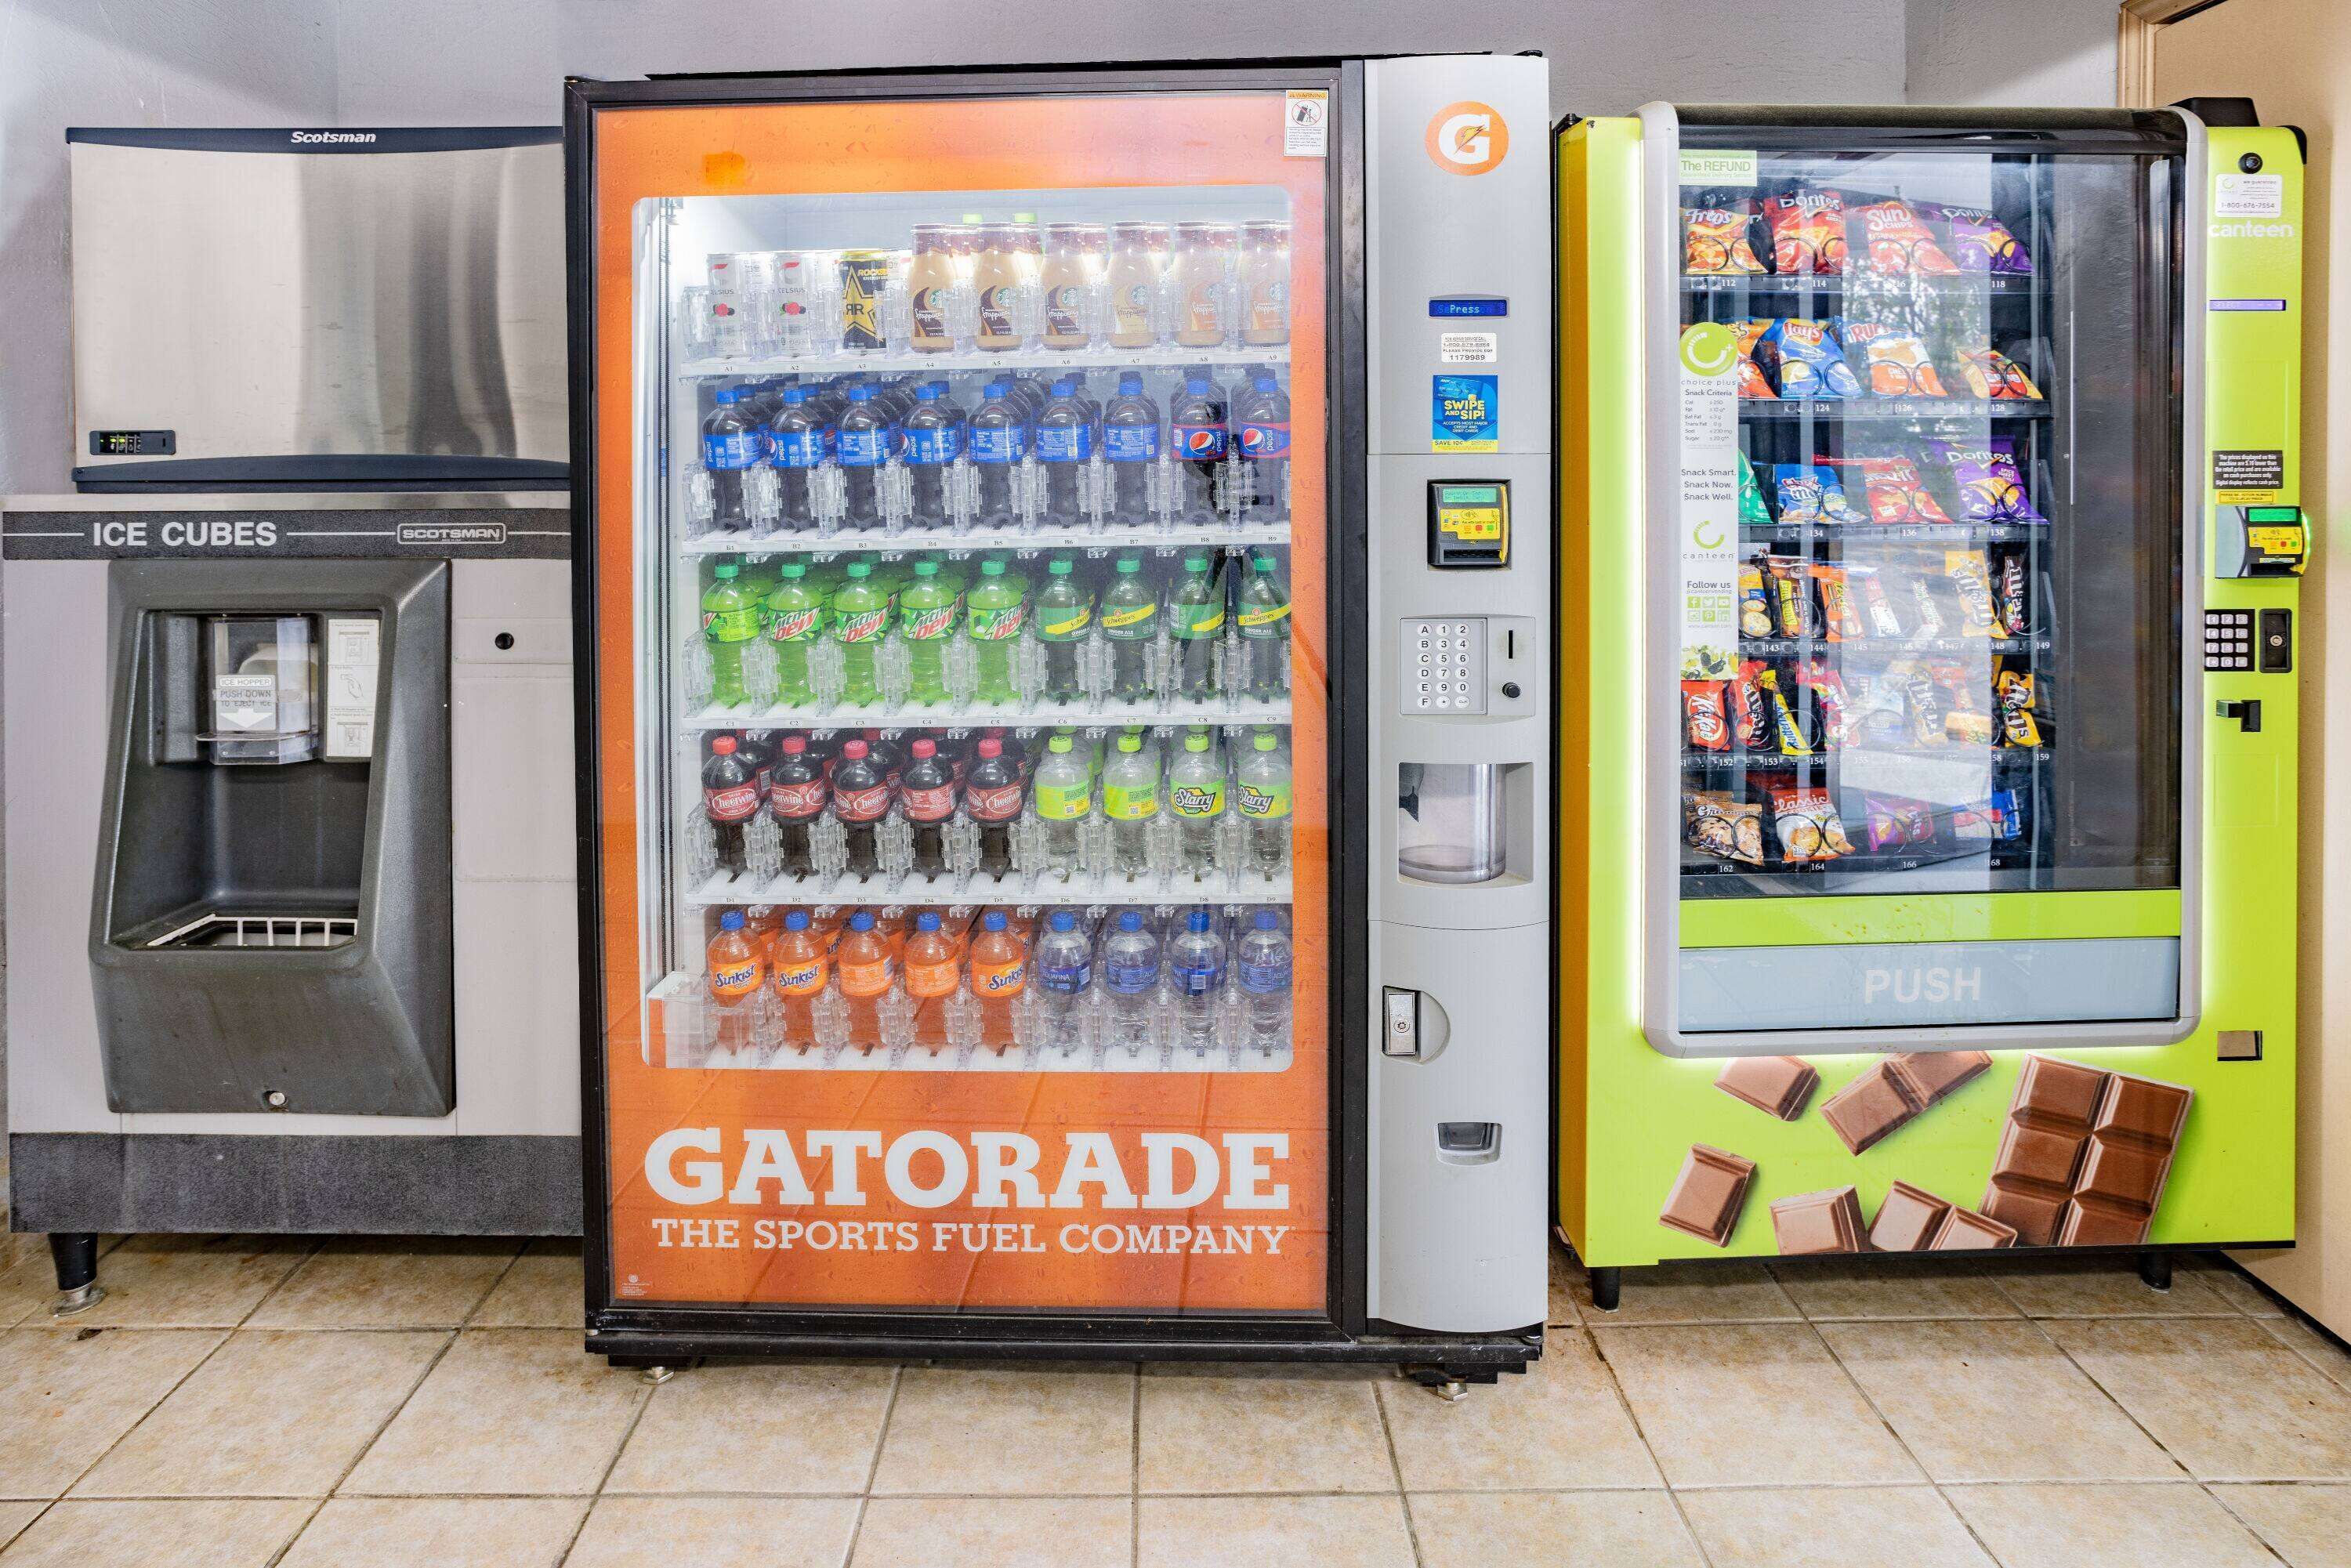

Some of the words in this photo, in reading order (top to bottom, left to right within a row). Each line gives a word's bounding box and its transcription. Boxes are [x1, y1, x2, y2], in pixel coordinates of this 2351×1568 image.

[291, 131, 376, 143] Scotsman
[1681, 160, 1701, 171] The
[1704, 160, 1751, 172] REFUND
[1780, 194, 1840, 211] Doritos
[1867, 208, 1911, 231] Sun
[2208, 221, 2294, 237] canteen
[1450, 305, 1480, 313] Press
[1785, 322, 1820, 340] Lay's
[1444, 400, 1484, 410] SWIPE
[1460, 410, 1485, 419] SIP!
[777, 440, 786, 461] pepsi
[909, 436, 918, 457] pepsi
[1946, 451, 2014, 464] Doritos
[94, 522, 147, 546] ICE
[161, 521, 277, 546] CUBES
[402, 529, 500, 539] SCOTSMAN
[774, 610, 817, 641] DEW
[845, 611, 886, 642] DEW
[915, 607, 953, 639] DEW
[1243, 614, 1274, 625] Schweppes
[712, 791, 756, 809] Cheerwine
[1174, 788, 1216, 812] Starry
[1239, 785, 1274, 813] Starry
[715, 964, 756, 987] Sunkist
[779, 964, 820, 987] Sunkist
[1865, 967, 1981, 1003] PUSH
[645, 1127, 1289, 1209] GATORADE
[652, 1219, 739, 1248] THE
[753, 1220, 919, 1251] SPORTS
[932, 1223, 1045, 1252] FUEL
[1059, 1224, 1288, 1254] COMPANY
